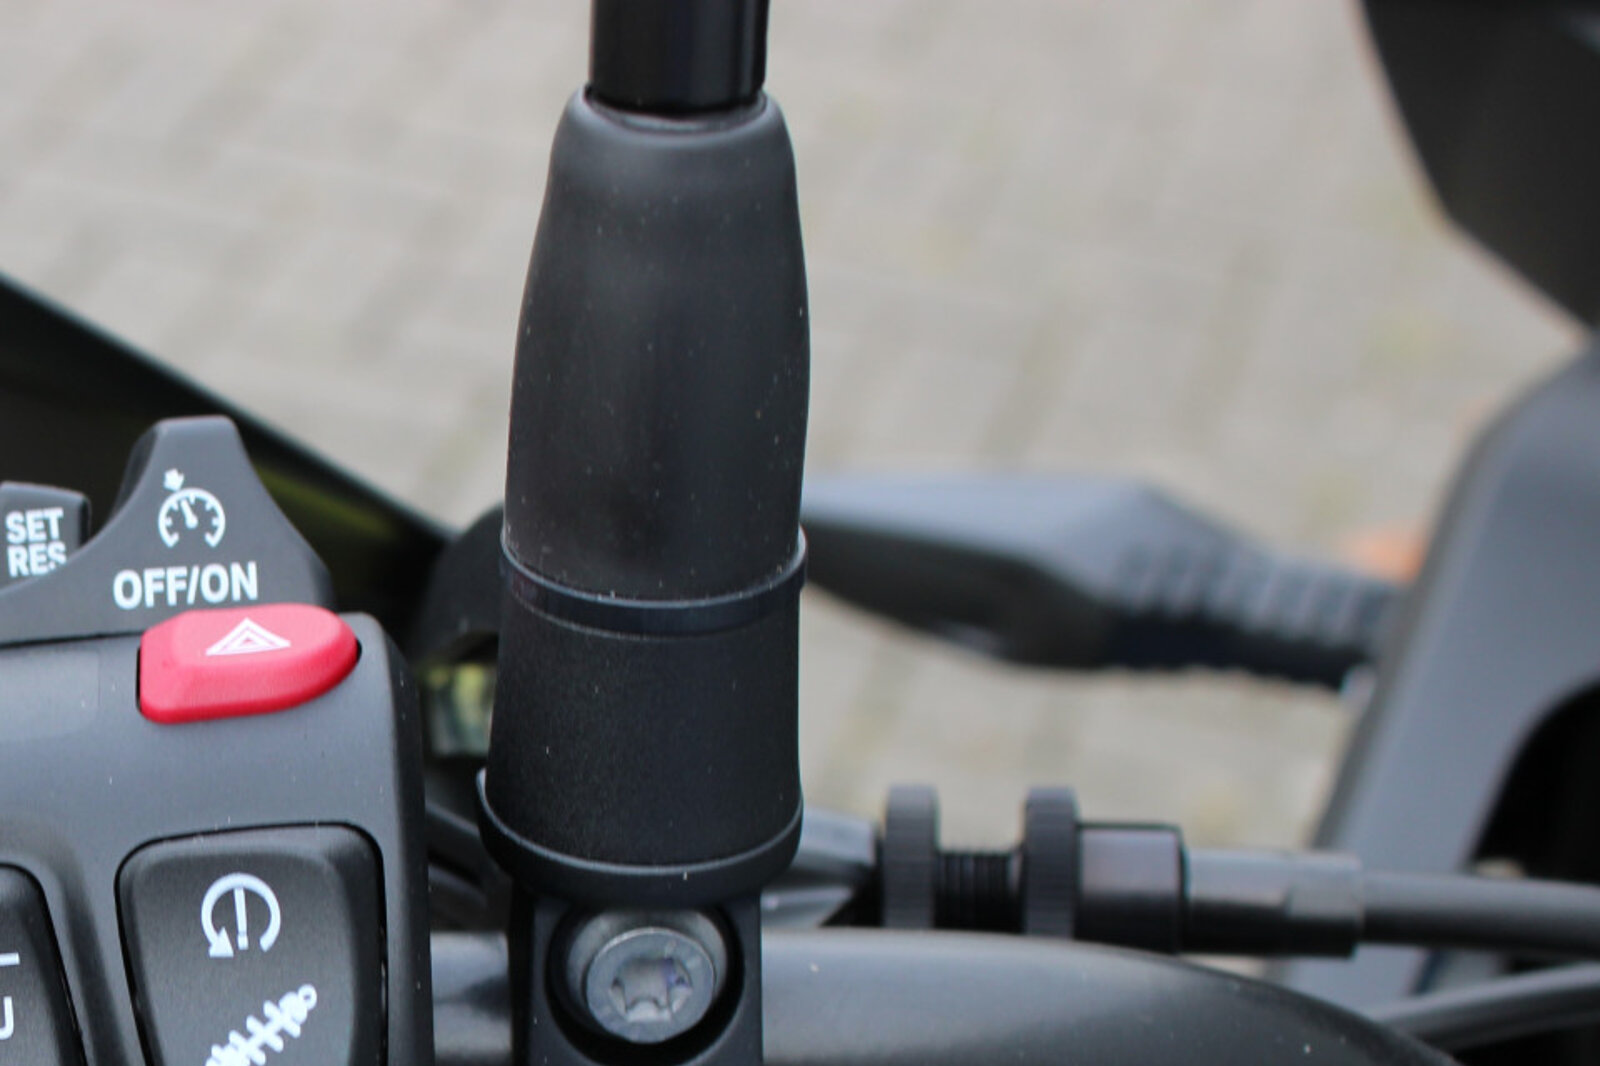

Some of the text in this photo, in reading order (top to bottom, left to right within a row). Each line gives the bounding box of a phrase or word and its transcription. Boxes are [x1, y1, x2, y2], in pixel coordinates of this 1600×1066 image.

[5, 507, 64, 544] SET
[7, 541, 67, 577] RES
[112, 561, 259, 610] OFF/ON
